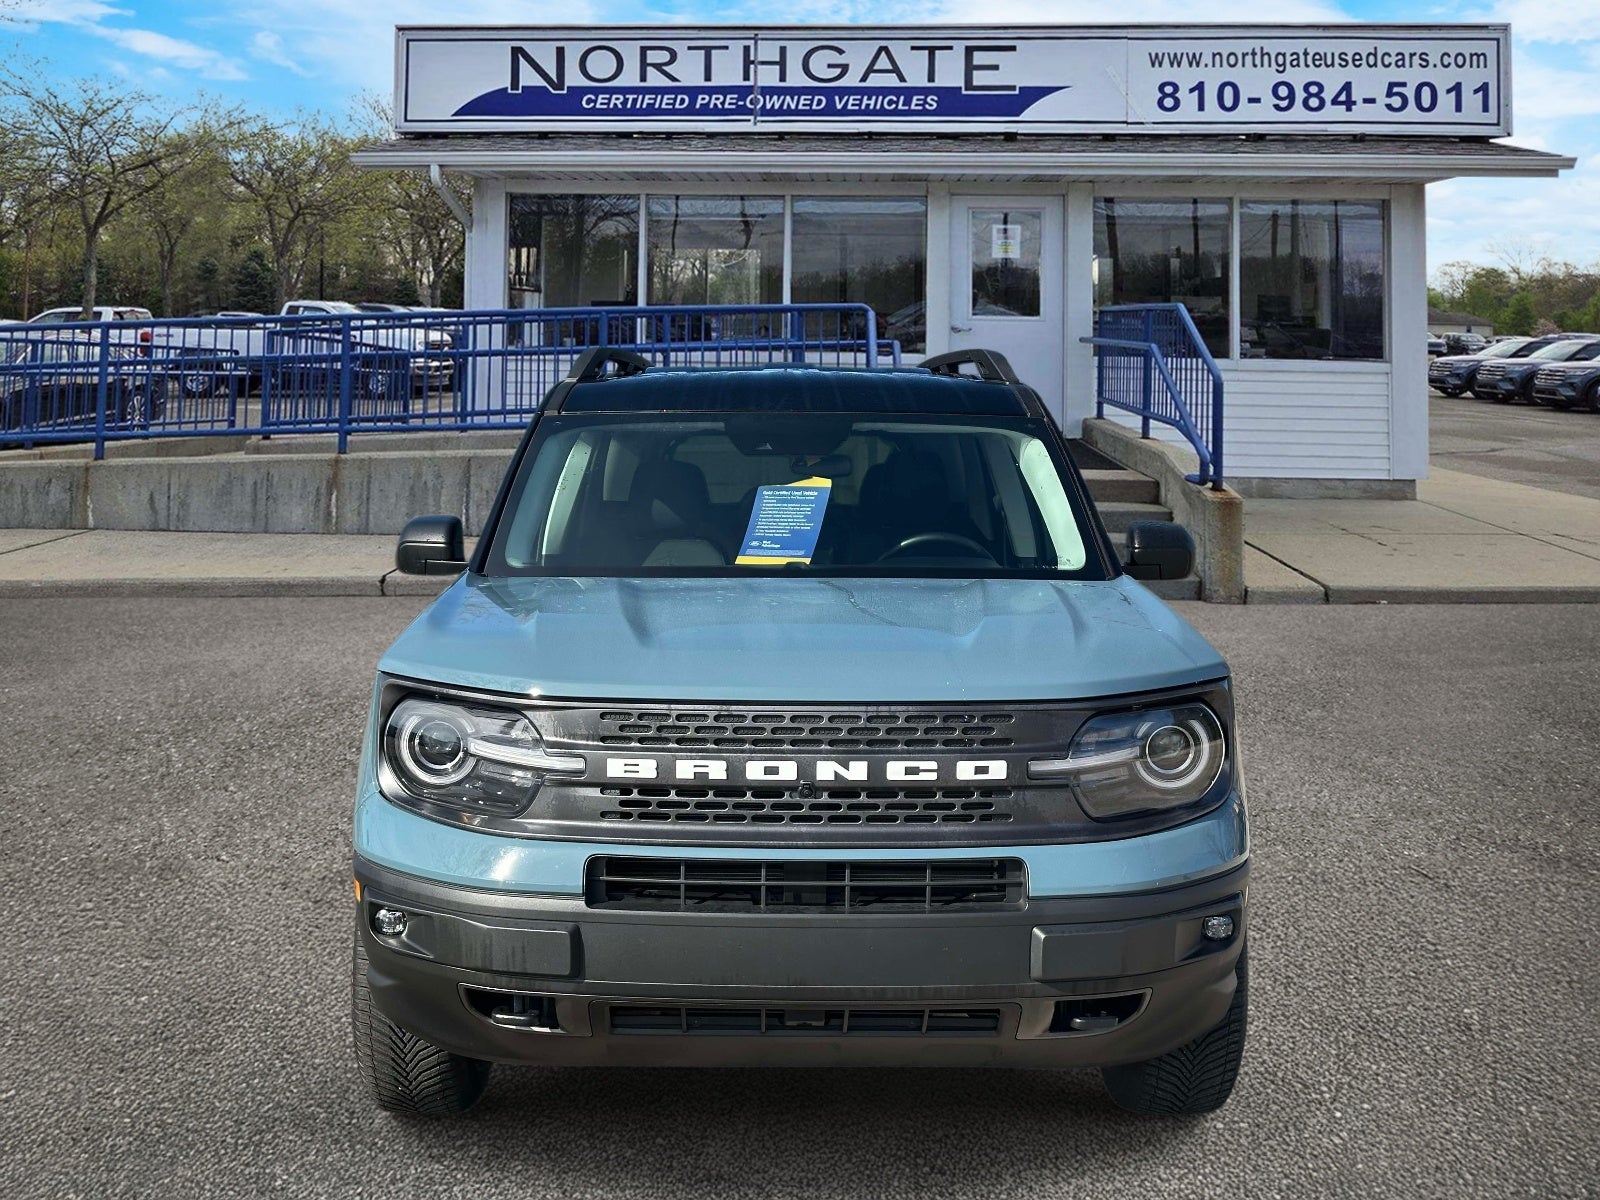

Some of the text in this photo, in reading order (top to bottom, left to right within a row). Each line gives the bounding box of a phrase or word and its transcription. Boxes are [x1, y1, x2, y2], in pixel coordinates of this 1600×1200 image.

[509, 44, 1018, 93] NORTHGATE
[1148, 47, 1489, 74] www.northgateusedcars.com
[580, 93, 939, 111] CERTIFIED PRE-OWNED VEHICLES
[1156, 80, 1492, 114] 810-984-5011
[606, 757, 1008, 781] BRONCO
